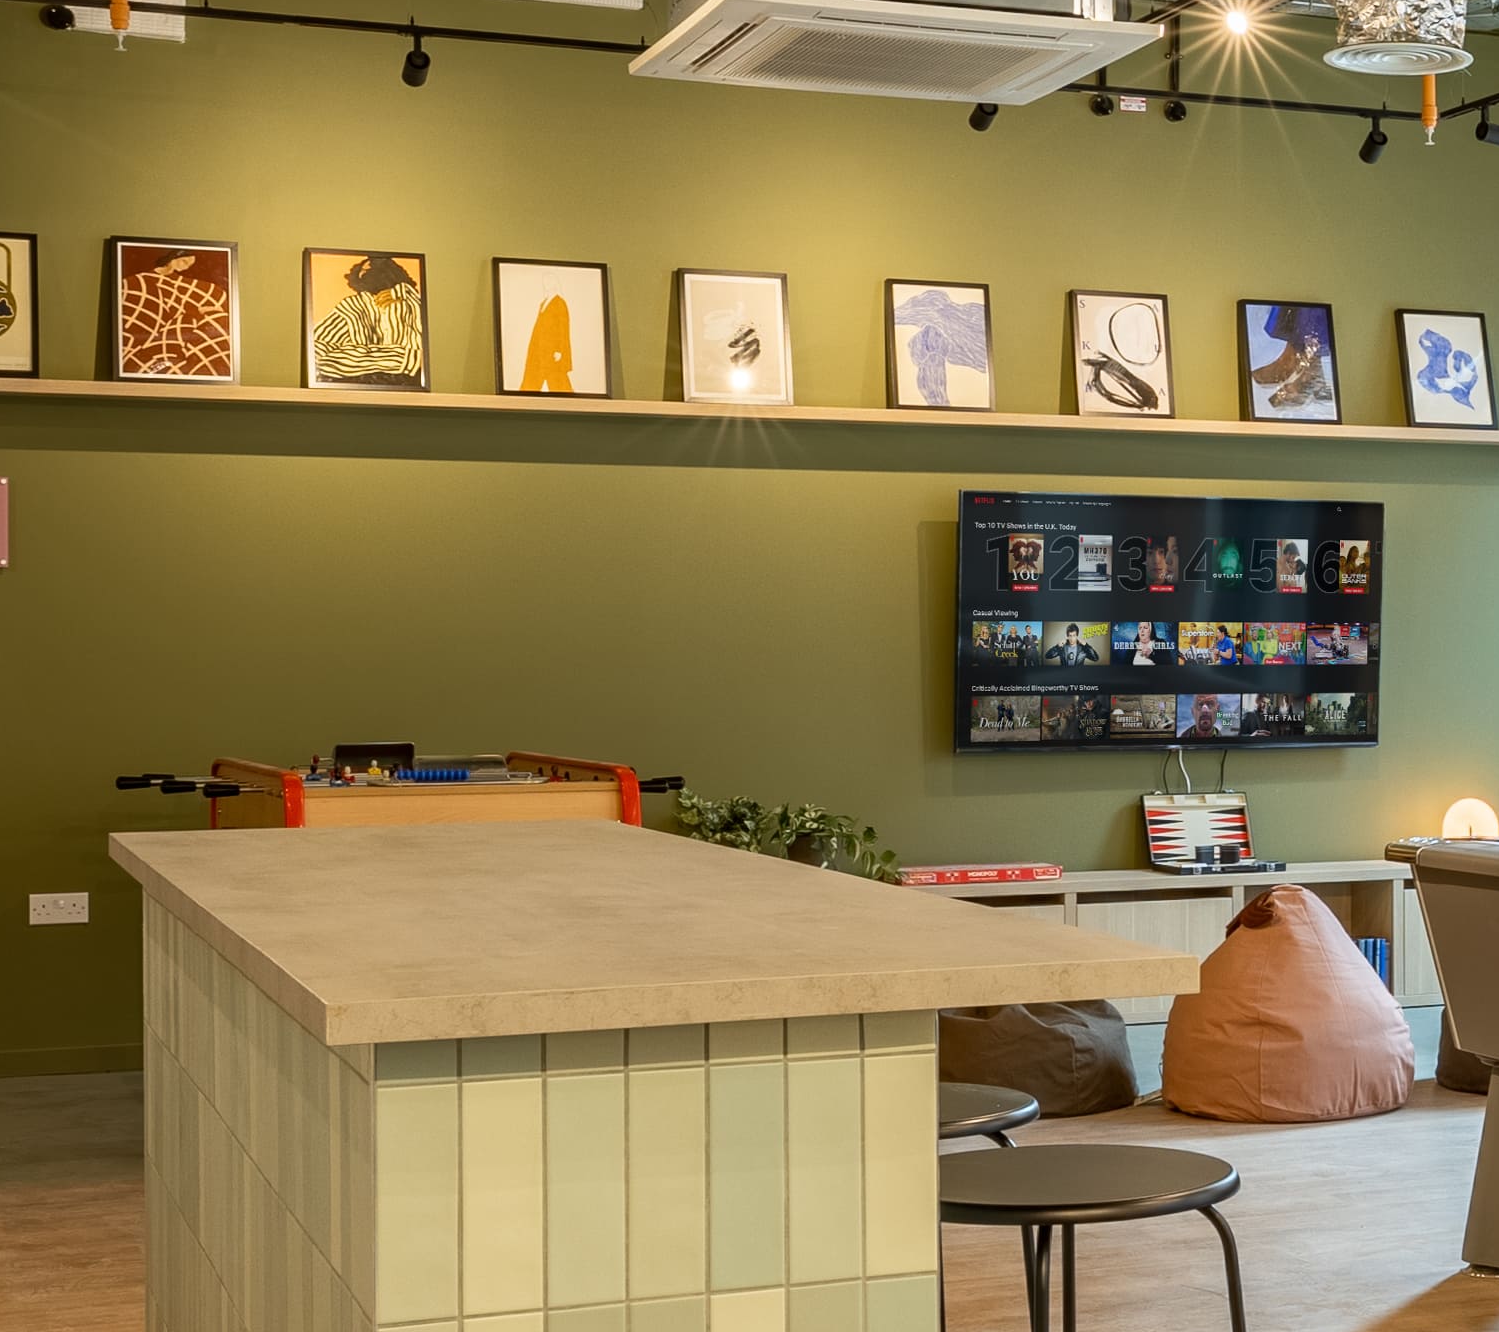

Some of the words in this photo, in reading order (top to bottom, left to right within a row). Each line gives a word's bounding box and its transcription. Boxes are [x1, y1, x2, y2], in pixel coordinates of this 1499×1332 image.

[1007, 522, 1026, 530] Shows
[1012, 569, 1040, 581] YOU
[994, 610, 1018, 618] Viewing
[1278, 642, 1302, 650] NEXT
[1282, 714, 1302, 722] FALL
